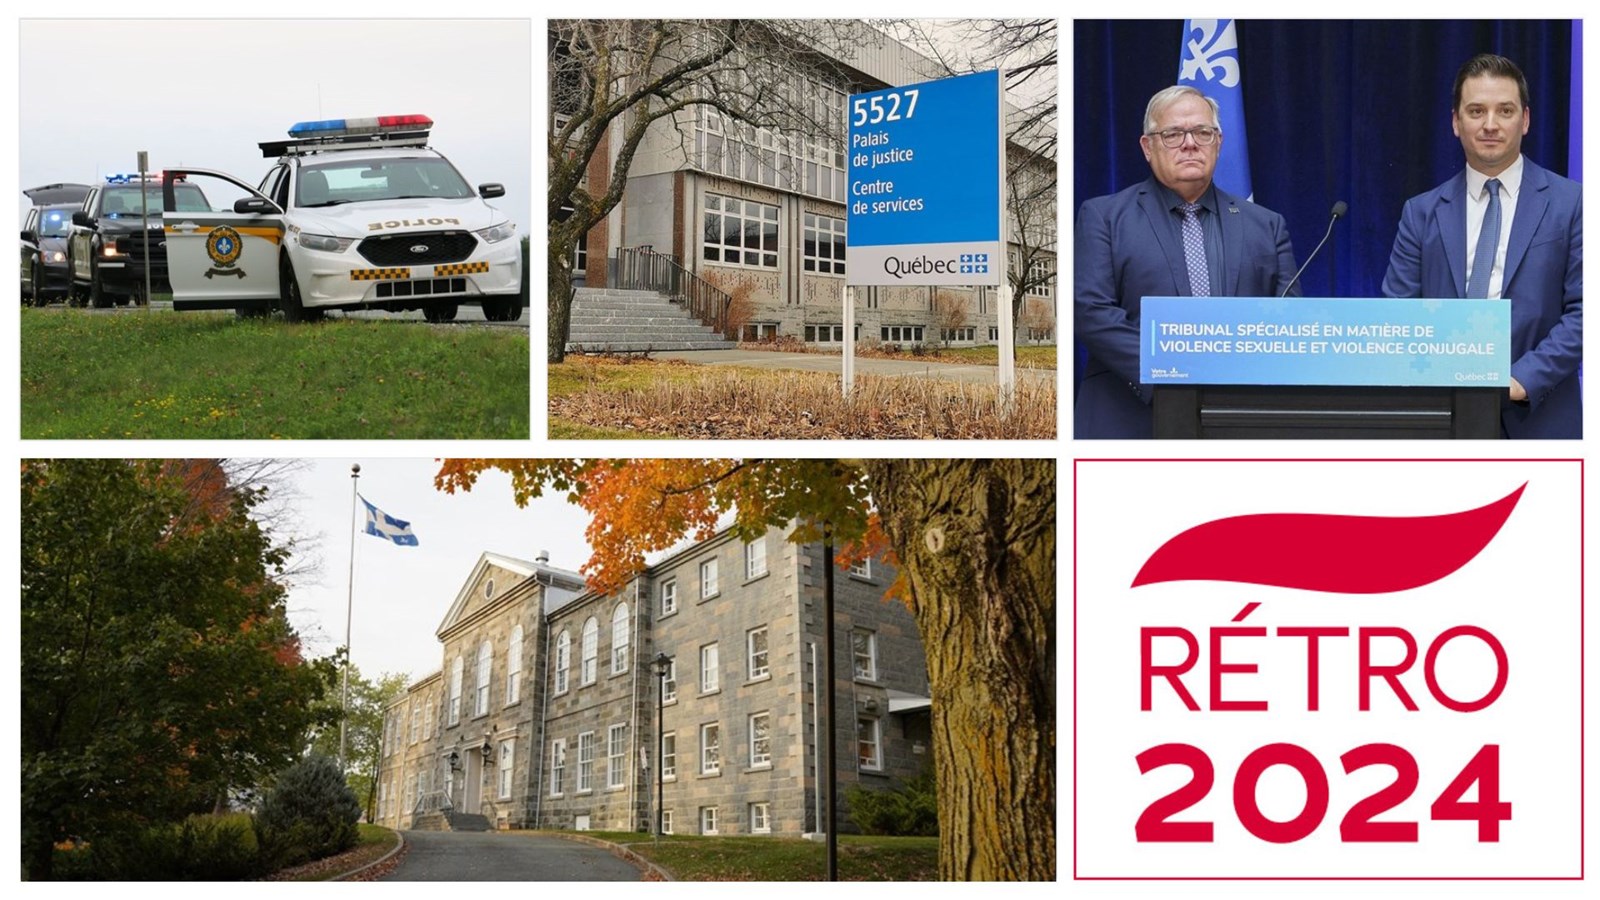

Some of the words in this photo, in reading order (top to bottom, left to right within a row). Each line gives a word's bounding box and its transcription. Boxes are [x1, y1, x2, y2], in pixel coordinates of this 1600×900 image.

[853, 89, 919, 127] 5527
[853, 131, 889, 148] Palais
[853, 153, 868, 167] de
[871, 148, 913, 169] justice
[852, 180, 893, 195] Centre
[852, 200, 868, 215] de
[872, 196, 924, 213] services
[884, 256, 956, 279] Québec
[1160, 323, 1233, 336] TRIBUNAL
[1237, 321, 1320, 337] SPÉCIALISÉ
[1324, 325, 1342, 337] EN
[1347, 321, 1409, 337] MATIÈRE
[1415, 326, 1434, 337] DE
[1160, 340, 1231, 353] VIOLENCE
[1236, 341, 1306, 353] SEXUELLE
[1311, 342, 1328, 353] ET
[1333, 342, 1403, 354] VIOLENCE
[1408, 342, 1495, 355] CONJUGALE
[1454, 372, 1486, 382] Québec
